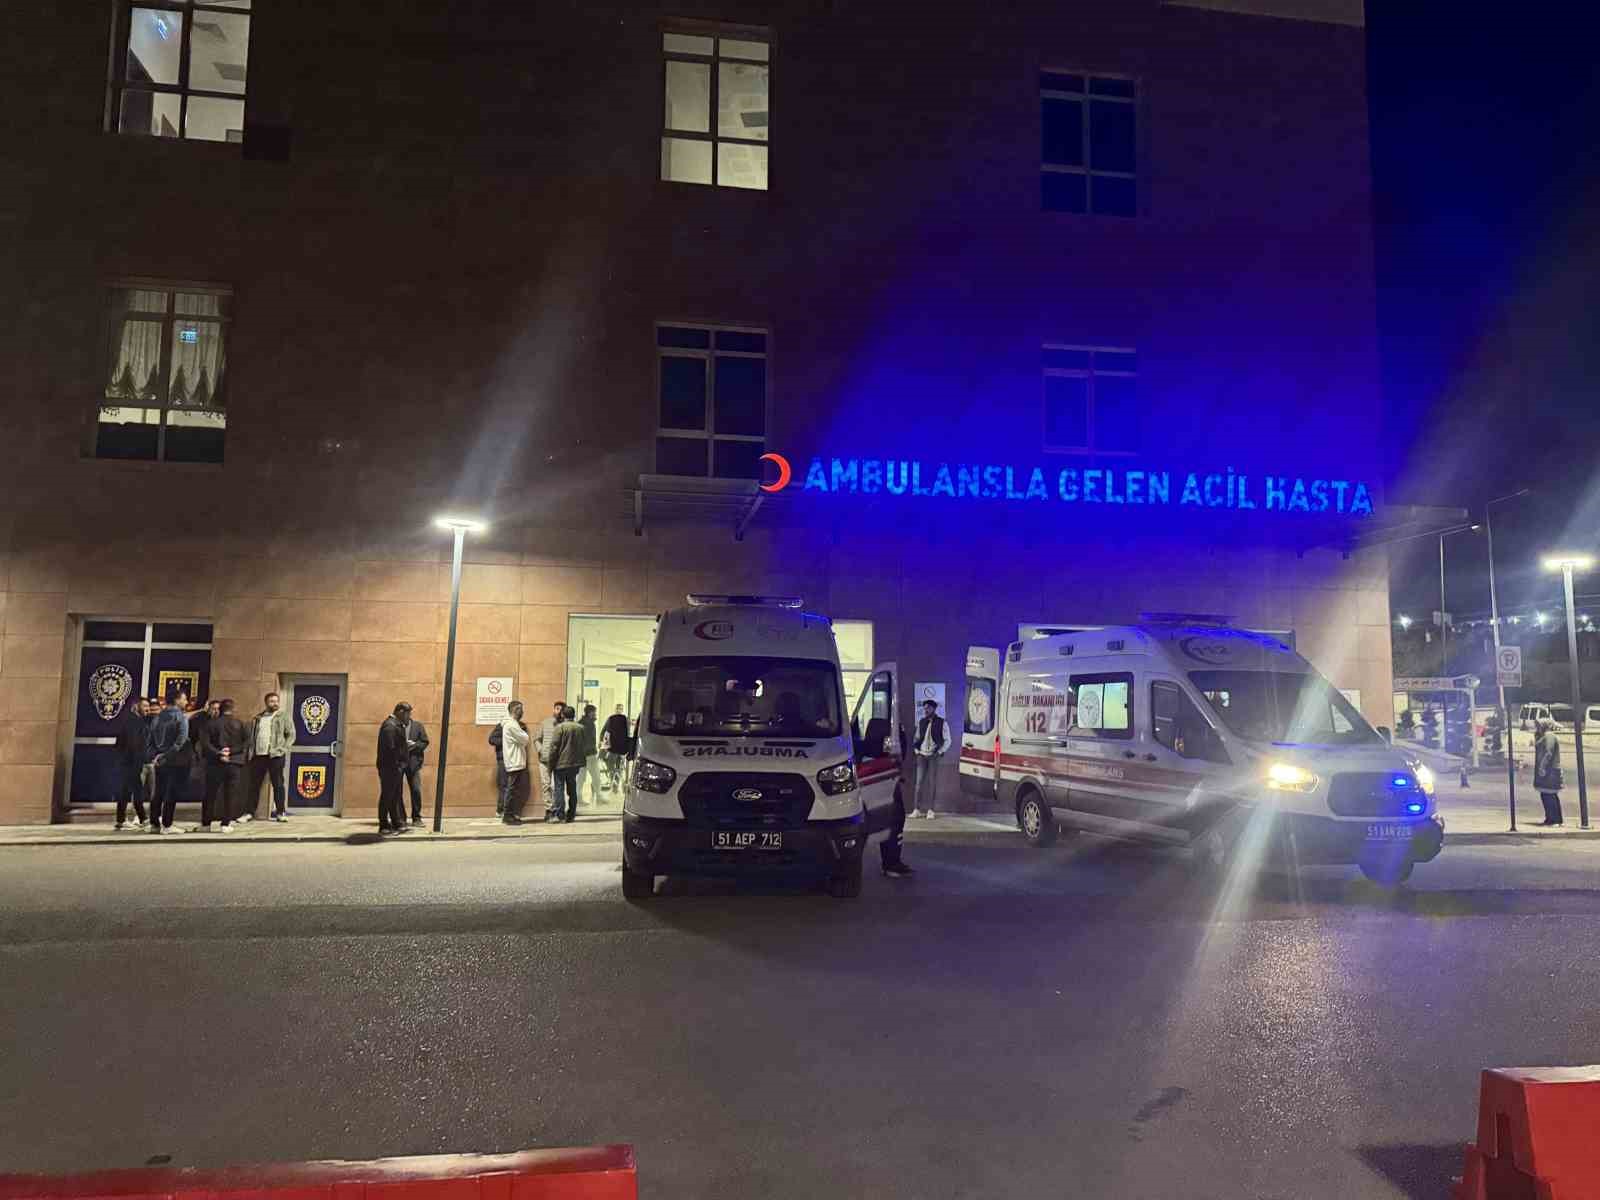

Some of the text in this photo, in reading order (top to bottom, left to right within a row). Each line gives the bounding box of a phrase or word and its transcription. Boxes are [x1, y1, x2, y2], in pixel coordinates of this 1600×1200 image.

[804, 457, 1374, 515] AMBULANSLA GELEN ACİL HASTA
[1025, 711, 1047, 734] 112
[718, 833, 780, 846] 51 AEP 712
